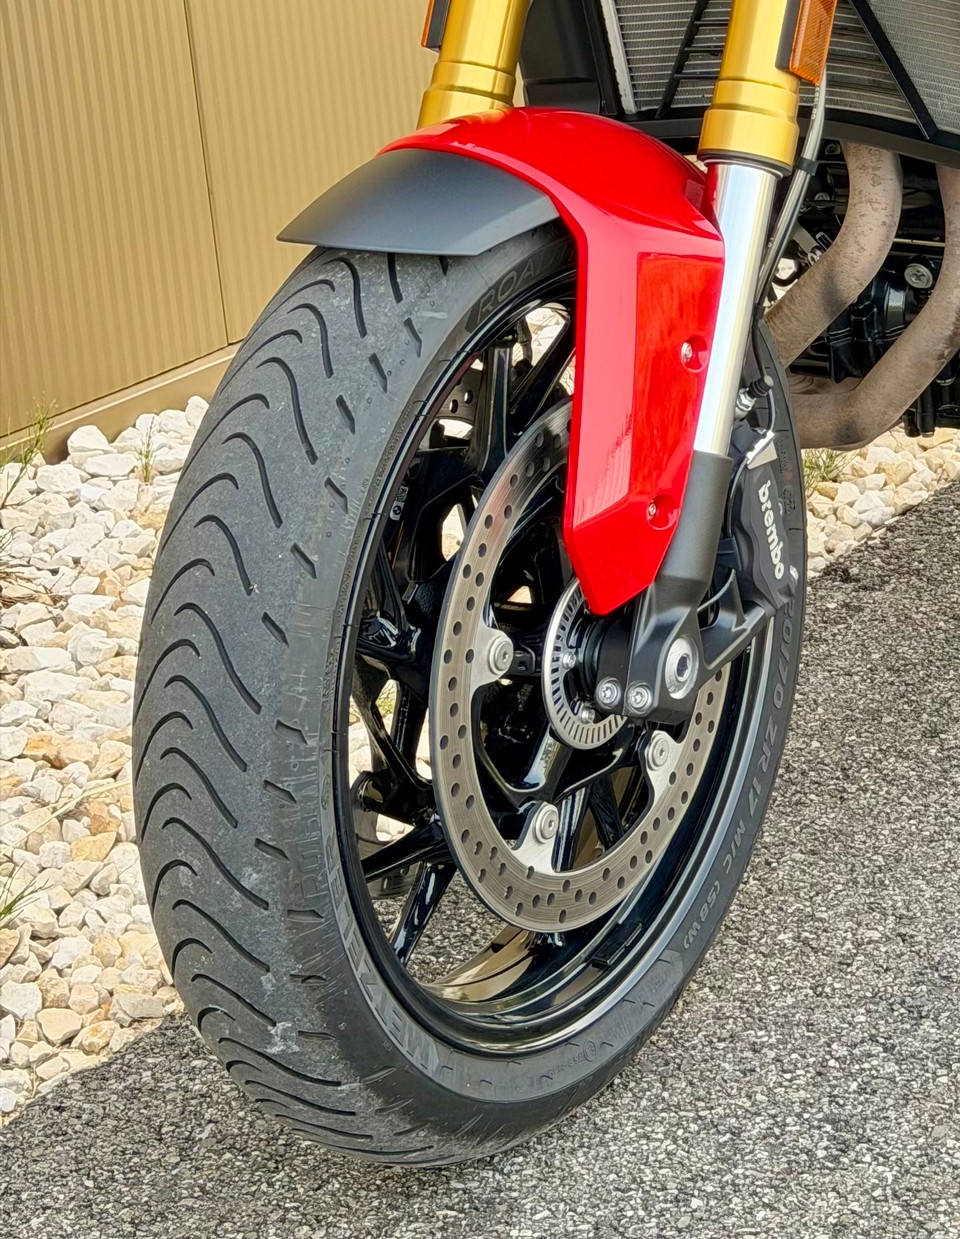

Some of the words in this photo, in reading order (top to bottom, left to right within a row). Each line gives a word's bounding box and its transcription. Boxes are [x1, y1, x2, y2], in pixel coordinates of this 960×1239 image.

[758, 479, 784, 580] brembo
[773, 597, 796, 709] 20/70
[757, 715, 778, 773] ZR
